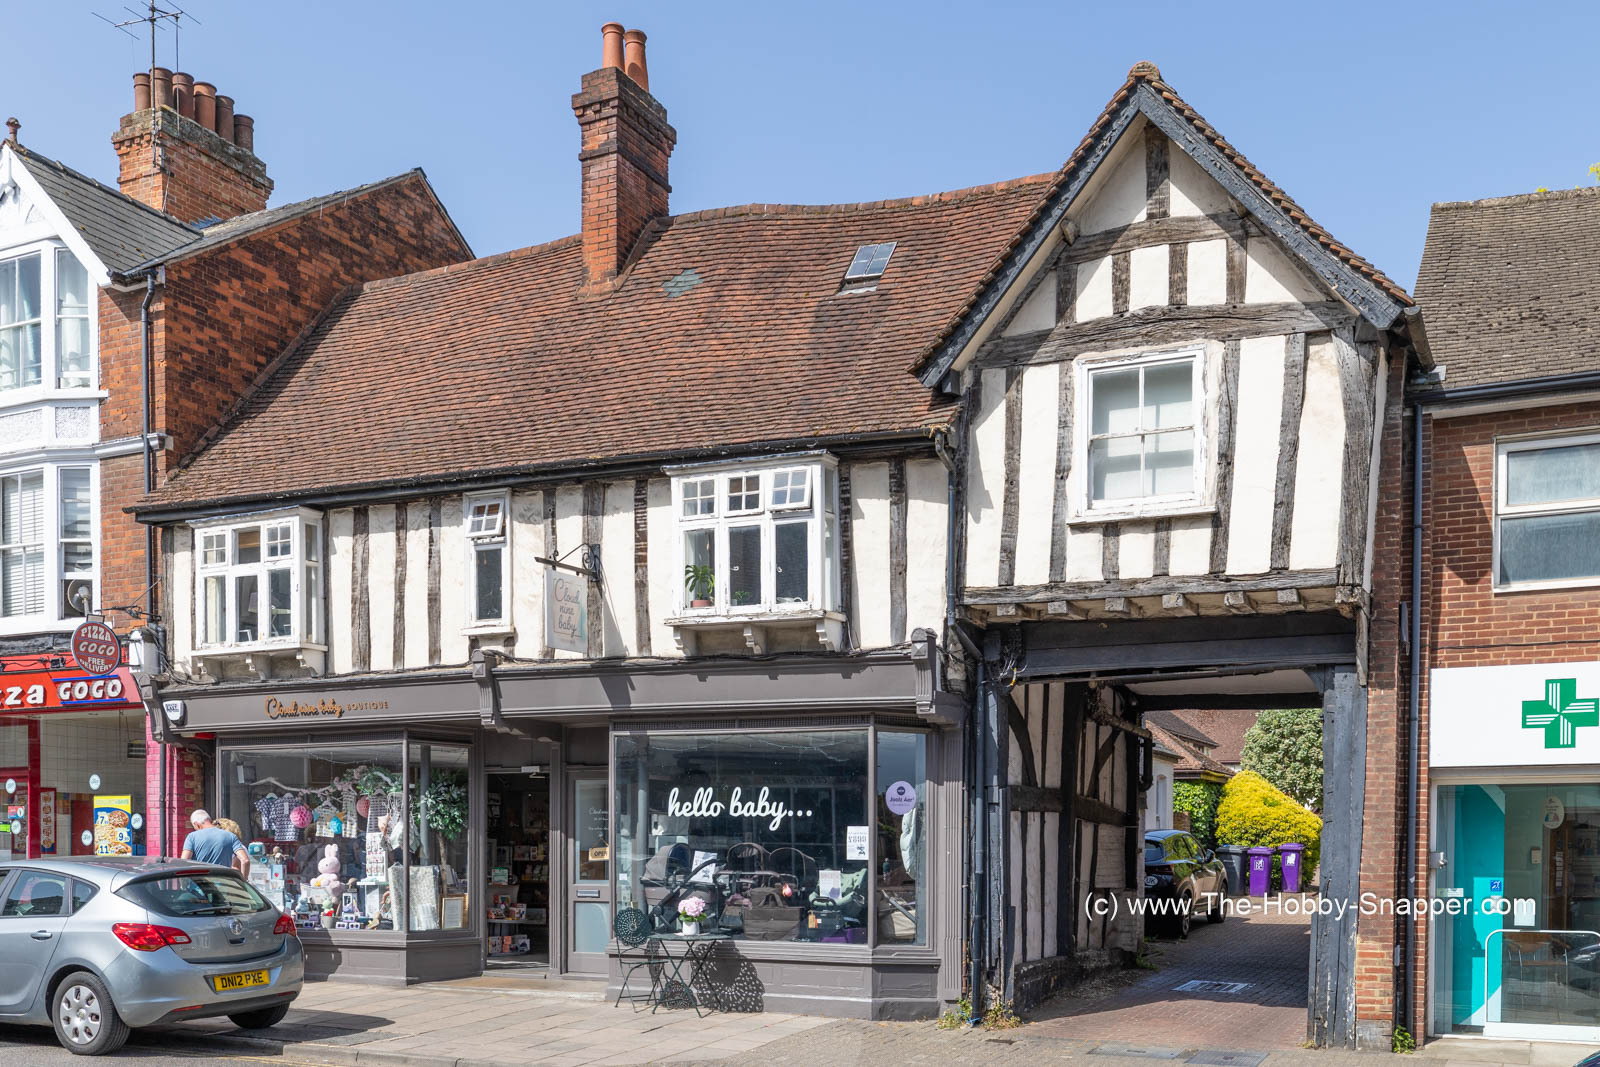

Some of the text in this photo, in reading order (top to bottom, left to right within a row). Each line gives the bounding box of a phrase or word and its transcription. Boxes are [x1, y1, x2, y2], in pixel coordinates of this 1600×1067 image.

[554, 578, 580, 604] Cloud
[559, 603, 575, 616] nine
[80, 625, 112, 642] PIZZA
[558, 615, 577, 637] baby
[79, 641, 115, 656] GOGO
[79, 658, 113, 673] DELIVERY
[88, 656, 105, 665] FREE
[0, 679, 122, 706] za GOGO
[264, 695, 298, 719] Cloud
[318, 696, 343, 718] baby
[346, 700, 389, 711] BOUTIQUE
[668, 786, 725, 817] hello
[245, 972, 264, 984] PXE
